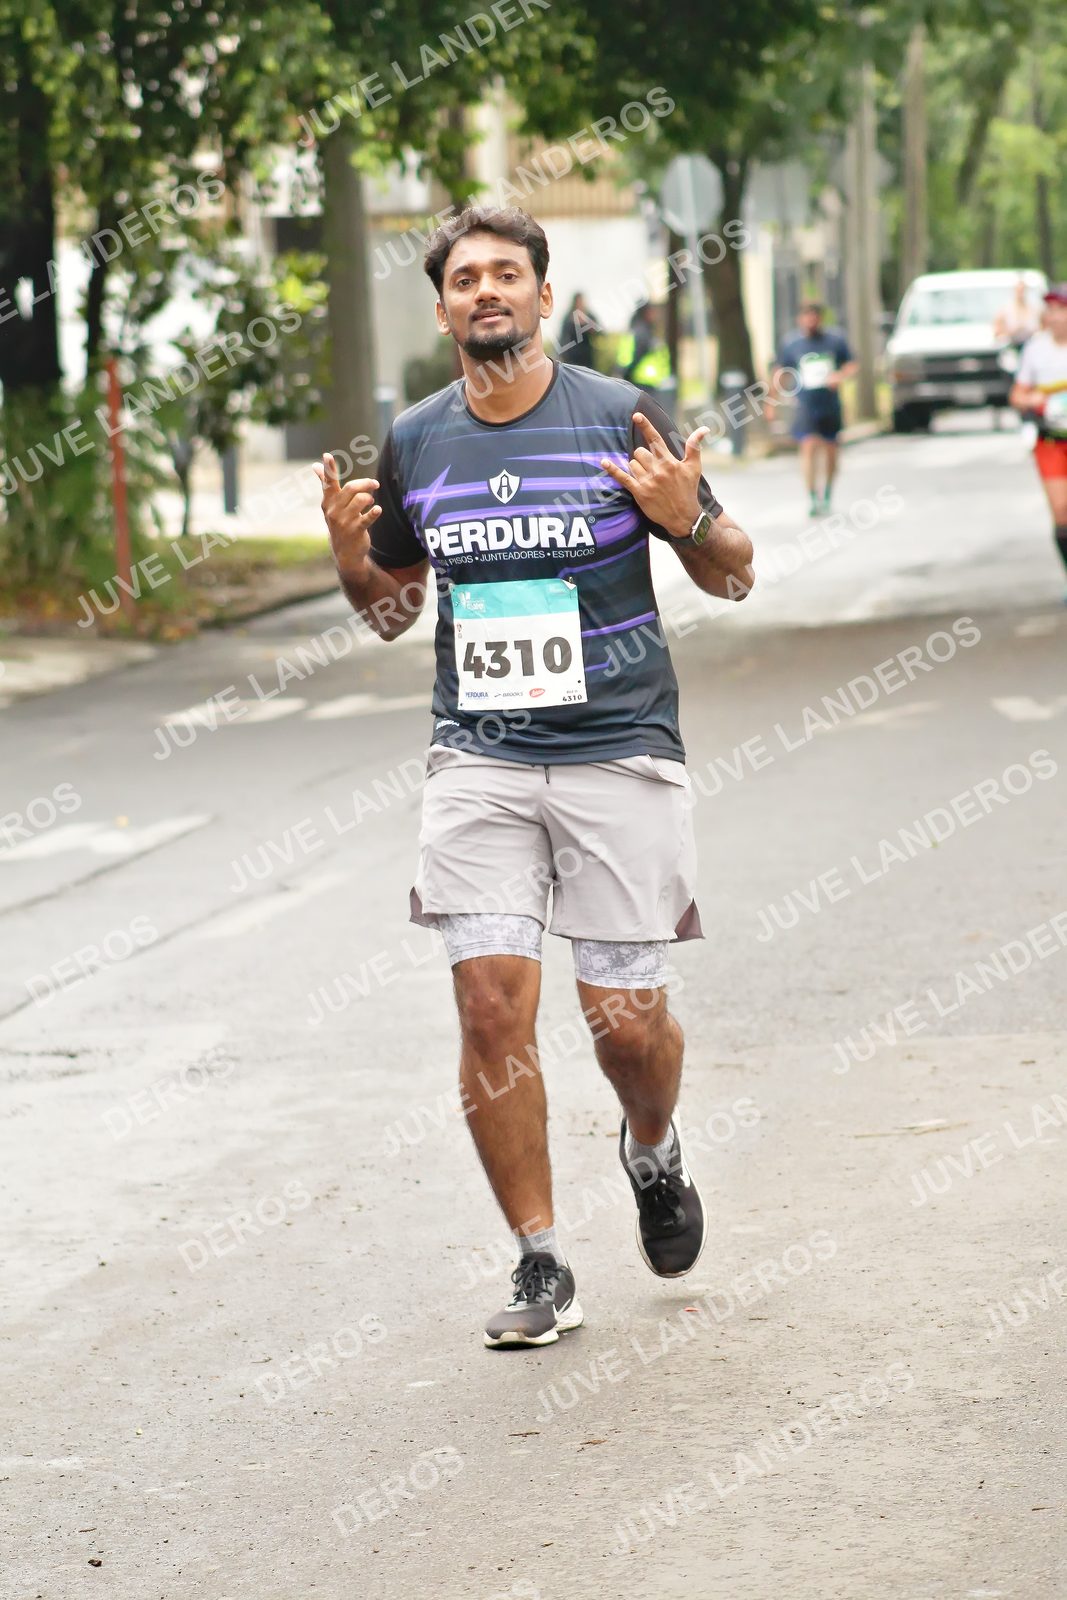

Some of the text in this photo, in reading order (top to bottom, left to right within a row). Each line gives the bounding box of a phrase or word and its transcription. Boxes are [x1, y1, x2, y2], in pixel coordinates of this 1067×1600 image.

[449, 554, 474, 566] PISOS
[480, 550, 545, 562] JUNTEADORES
[552, 547, 595, 559] ESTUCOS
[462, 636, 573, 679] 4310
[562, 694, 582, 702] 4310
